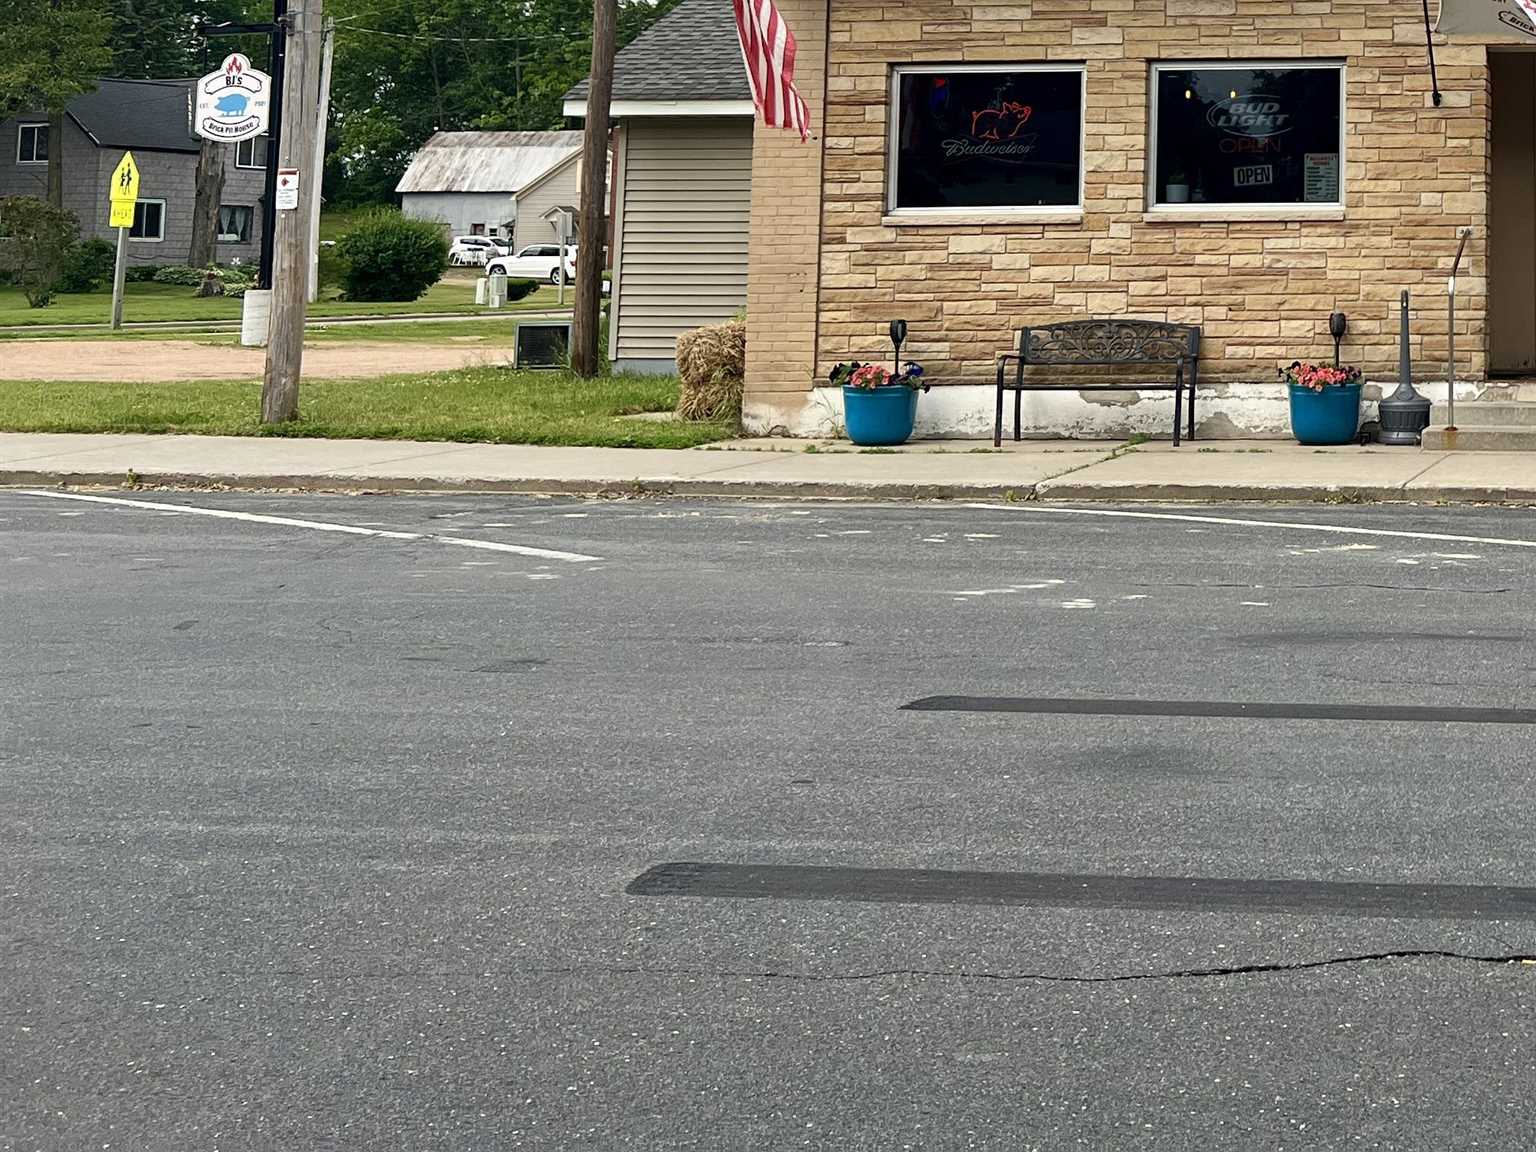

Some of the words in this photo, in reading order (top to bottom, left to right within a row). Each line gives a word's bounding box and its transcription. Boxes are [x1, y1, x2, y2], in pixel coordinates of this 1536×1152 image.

[1509, 17, 1535, 32] Brick
[1229, 103, 1280, 114] BUD
[1217, 114, 1289, 127] LIGHT
[941, 139, 1031, 157] Budweiser
[1236, 167, 1271, 185] OPEN
